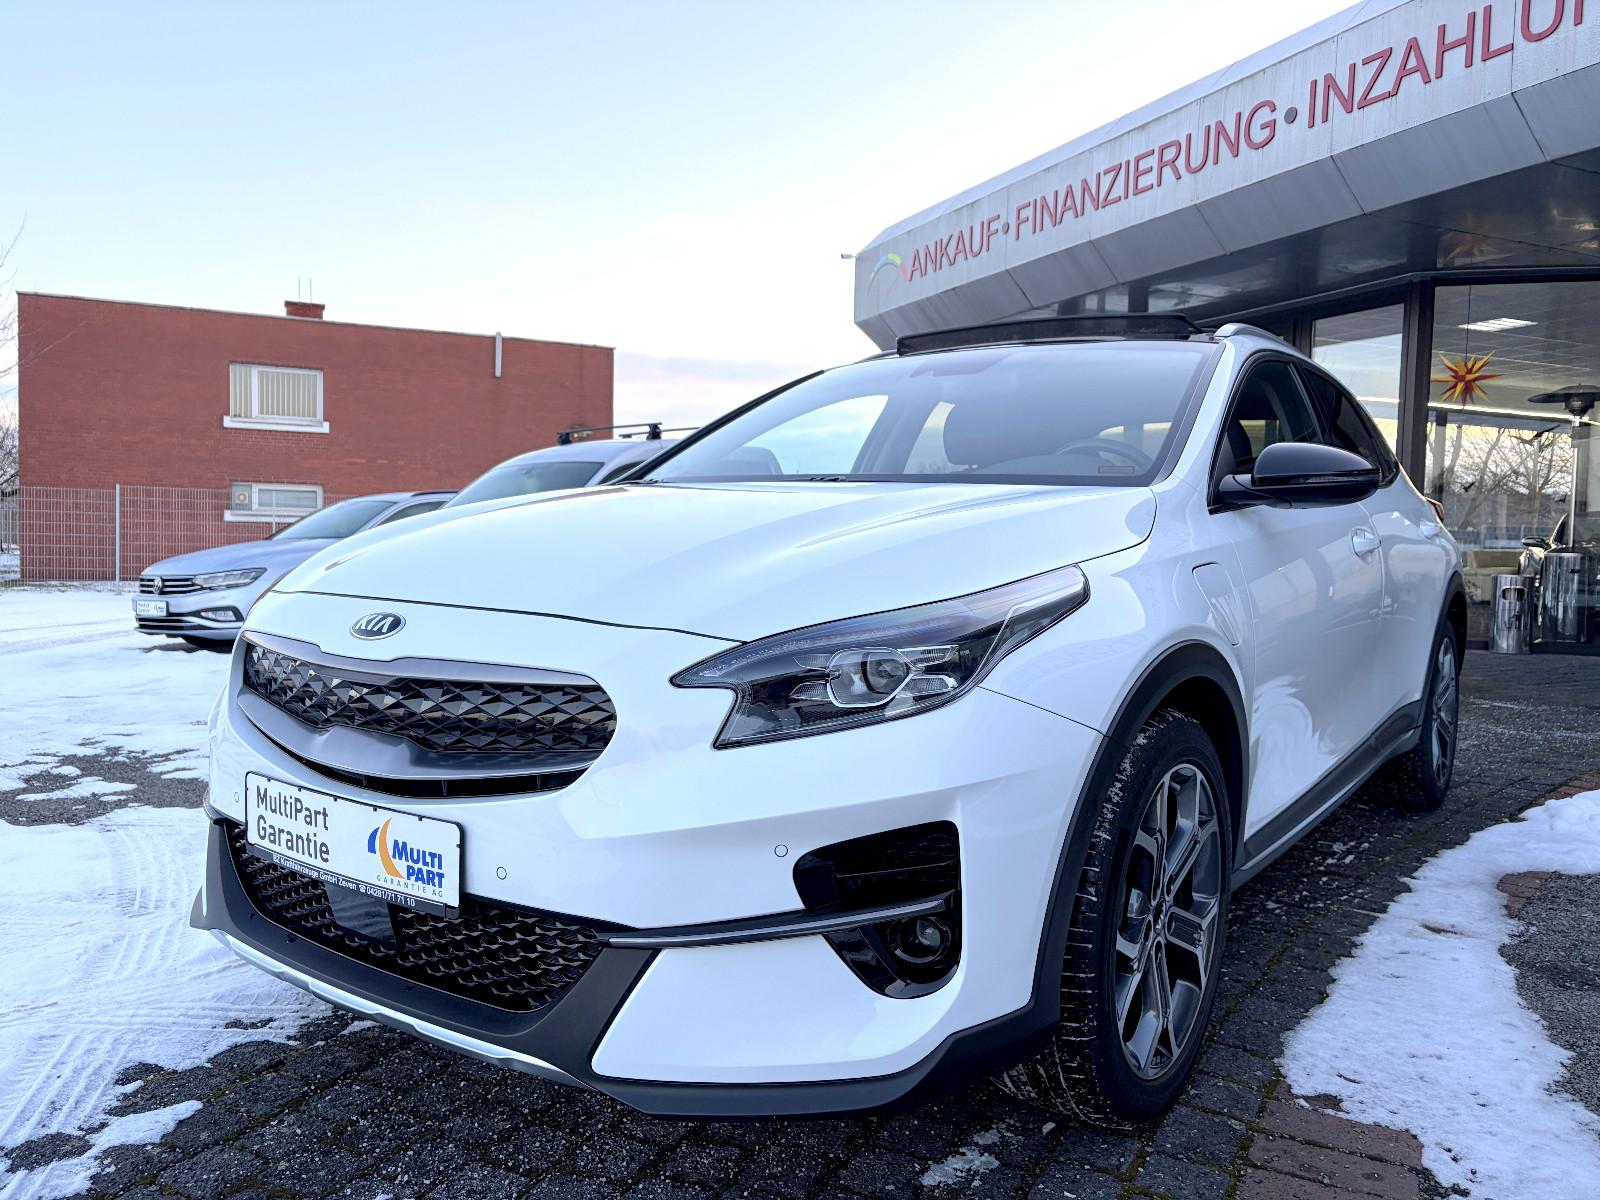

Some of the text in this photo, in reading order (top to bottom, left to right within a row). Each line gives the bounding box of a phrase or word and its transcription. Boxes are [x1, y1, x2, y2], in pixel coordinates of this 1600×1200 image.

[908, 214, 1001, 282] ANKAUF
[1015, 99, 1277, 241] FINANZIERUNG
[355, 614, 394, 633] KIA
[256, 785, 329, 831] MultiPart
[256, 814, 330, 863] Garantie
[392, 839, 443, 870] MULTI
[319, 870, 338, 885] GmbH
[338, 877, 357, 891] Zeven
[406, 898, 416, 907] 10
[376, 874, 443, 898] GARANTIE AG
[406, 864, 445, 889] PART
